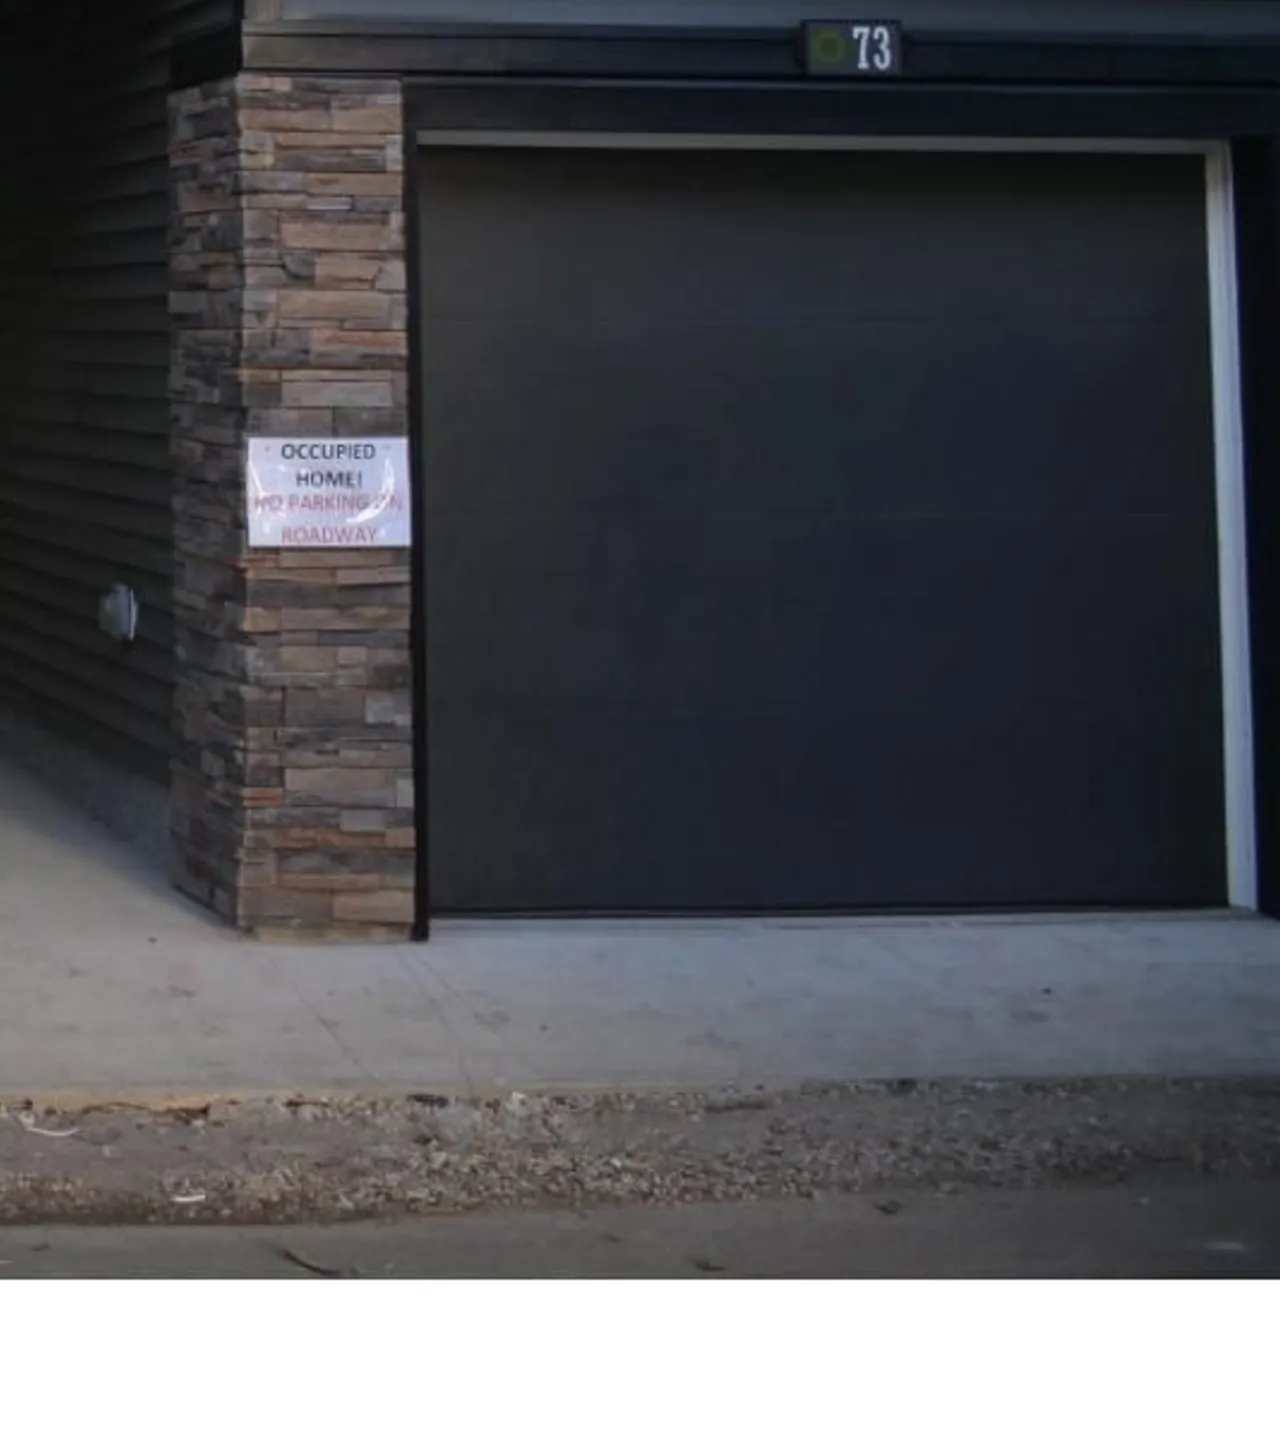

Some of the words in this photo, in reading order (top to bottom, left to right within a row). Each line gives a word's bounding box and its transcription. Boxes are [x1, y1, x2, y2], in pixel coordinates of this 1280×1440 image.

[852, 25, 891, 70] 73
[281, 443, 376, 460] OCCUPIED
[288, 493, 369, 511] PARKING
[281, 526, 377, 545] ROADWAY
